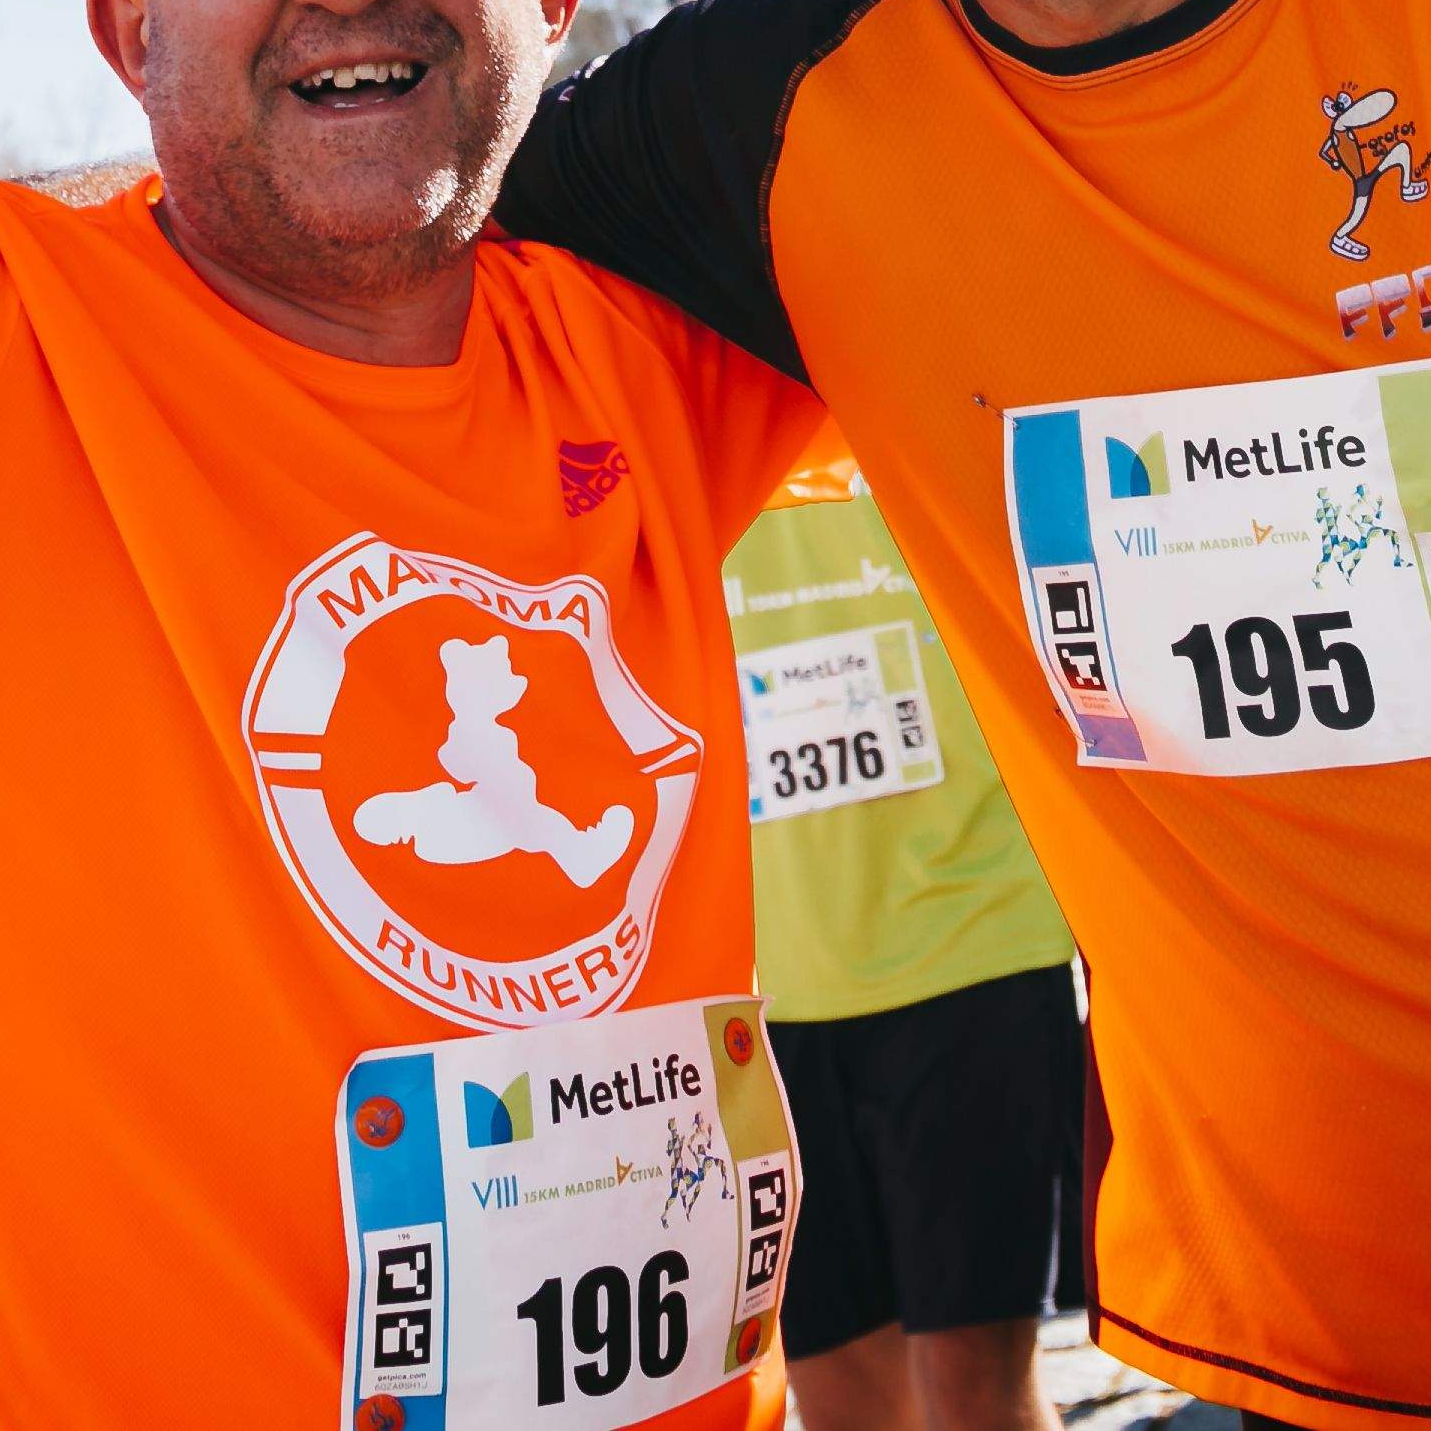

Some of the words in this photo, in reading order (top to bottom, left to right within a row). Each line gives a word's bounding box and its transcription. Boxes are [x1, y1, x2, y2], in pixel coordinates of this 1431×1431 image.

[1184, 425, 1367, 482] MetLife
[1114, 526, 1157, 557] VIII
[1162, 541, 1196, 555] 15KM
[1200, 535, 1254, 552] MADRID
[1171, 610, 1375, 740] 195
[769, 730, 885, 798] 3376
[376, 913, 641, 1013] RUNNERS
[550, 1053, 701, 1124] MetLife
[471, 1174, 519, 1211] VIII
[524, 1185, 559, 1204] 15KM
[565, 1175, 616, 1200] MADRID
[517, 1249, 690, 1407] 196
